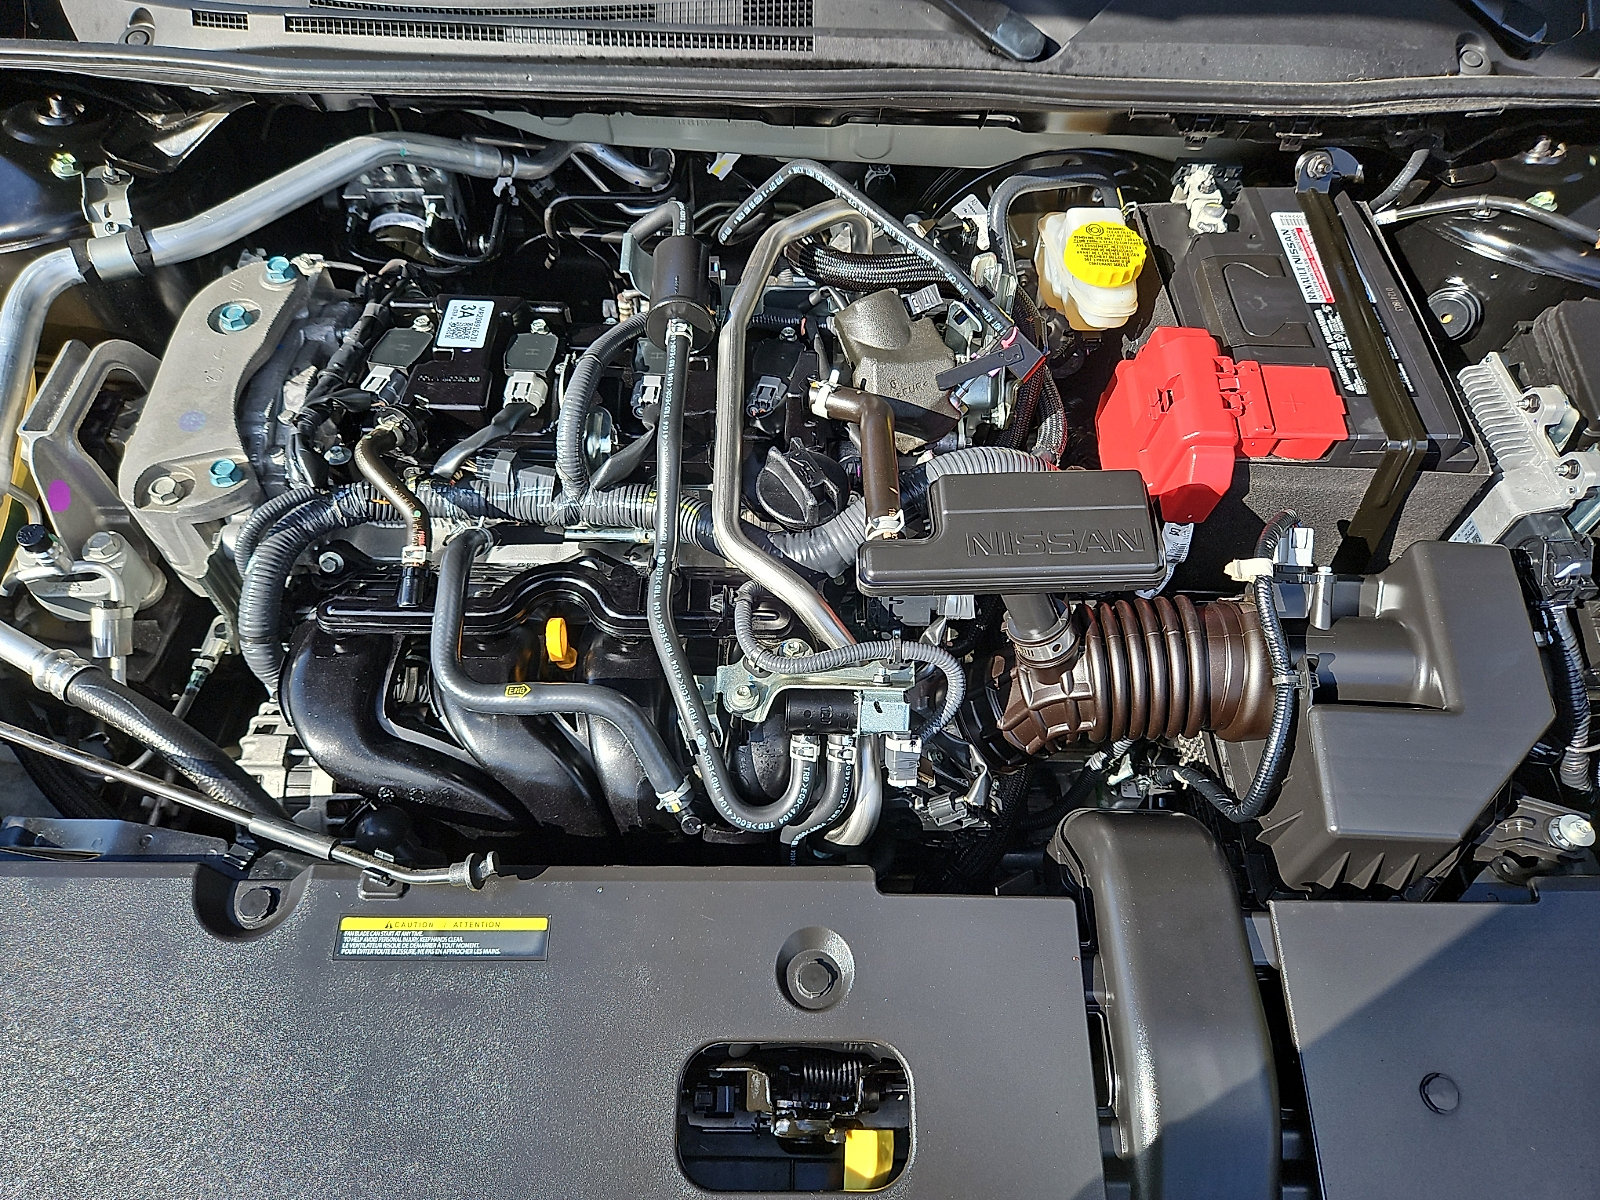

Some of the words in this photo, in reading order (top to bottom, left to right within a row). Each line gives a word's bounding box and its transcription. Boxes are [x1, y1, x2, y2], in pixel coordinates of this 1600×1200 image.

[1281, 229, 1302, 264] NISSAN
[458, 304, 477, 319] 3A
[966, 528, 1145, 557] NISSAN
